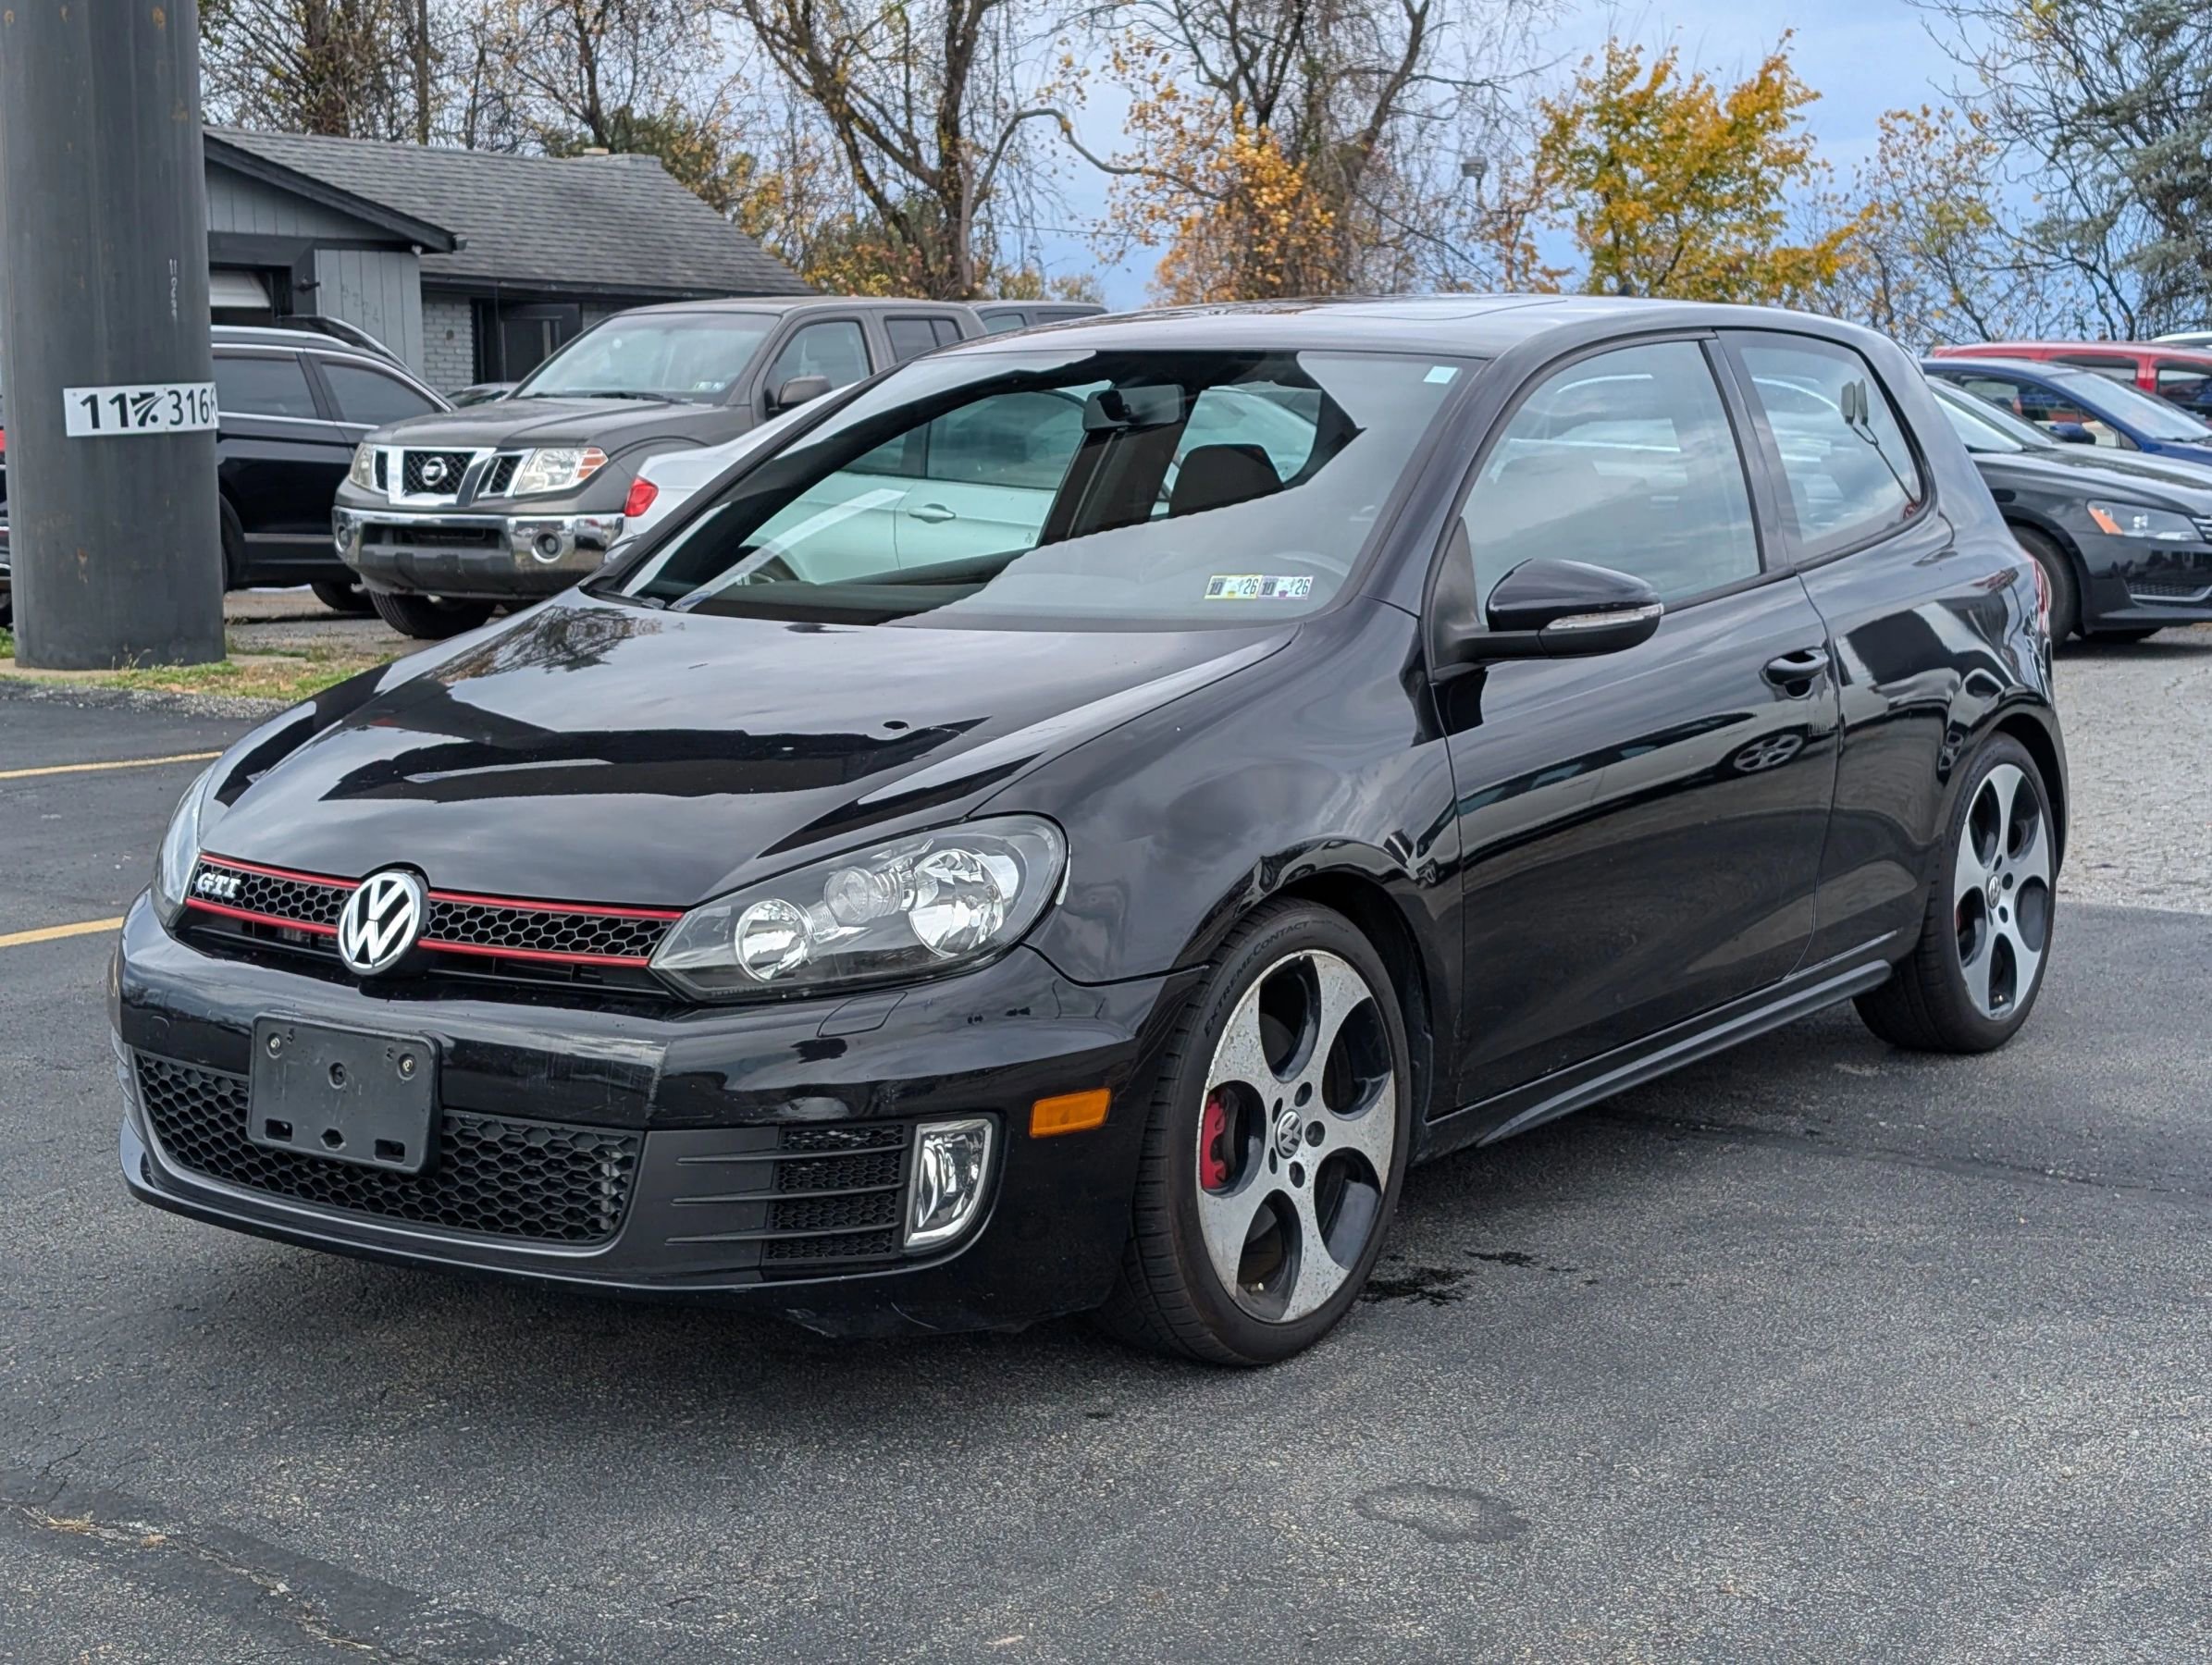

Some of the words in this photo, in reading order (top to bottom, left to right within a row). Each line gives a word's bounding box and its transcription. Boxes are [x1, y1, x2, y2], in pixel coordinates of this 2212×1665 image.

[1243, 578, 1259, 596] 26
[1295, 578, 1310, 595] 26
[197, 872, 241, 898] GTI
